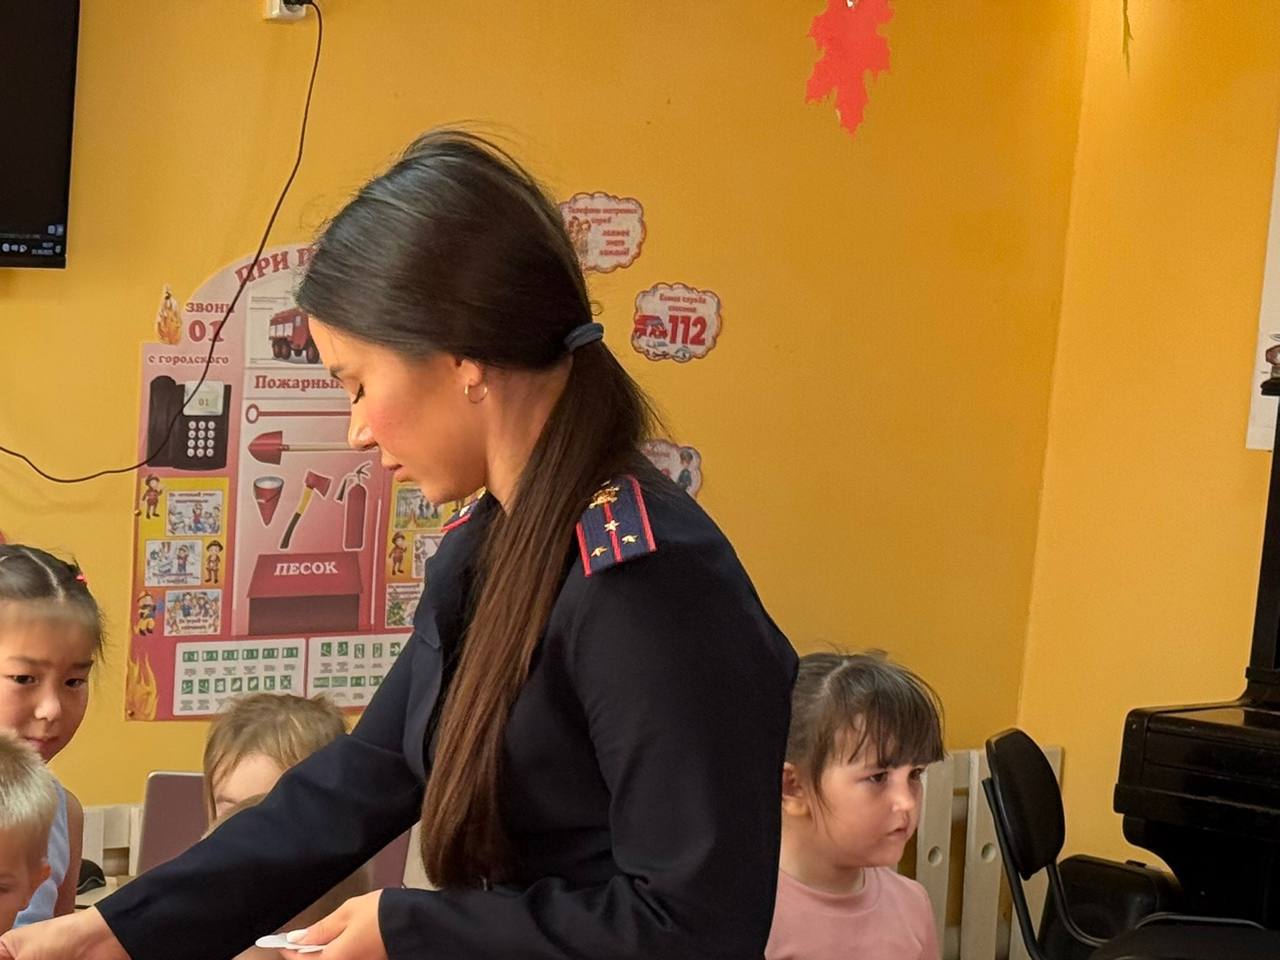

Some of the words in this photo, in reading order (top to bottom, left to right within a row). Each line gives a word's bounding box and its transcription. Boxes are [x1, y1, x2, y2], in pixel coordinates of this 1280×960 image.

[235, 250, 290, 283] ПРИ
[188, 319, 224, 342] 01
[668, 315, 708, 346] 112
[158, 355, 229, 367] городского
[274, 561, 339, 576] ПЕСОК
